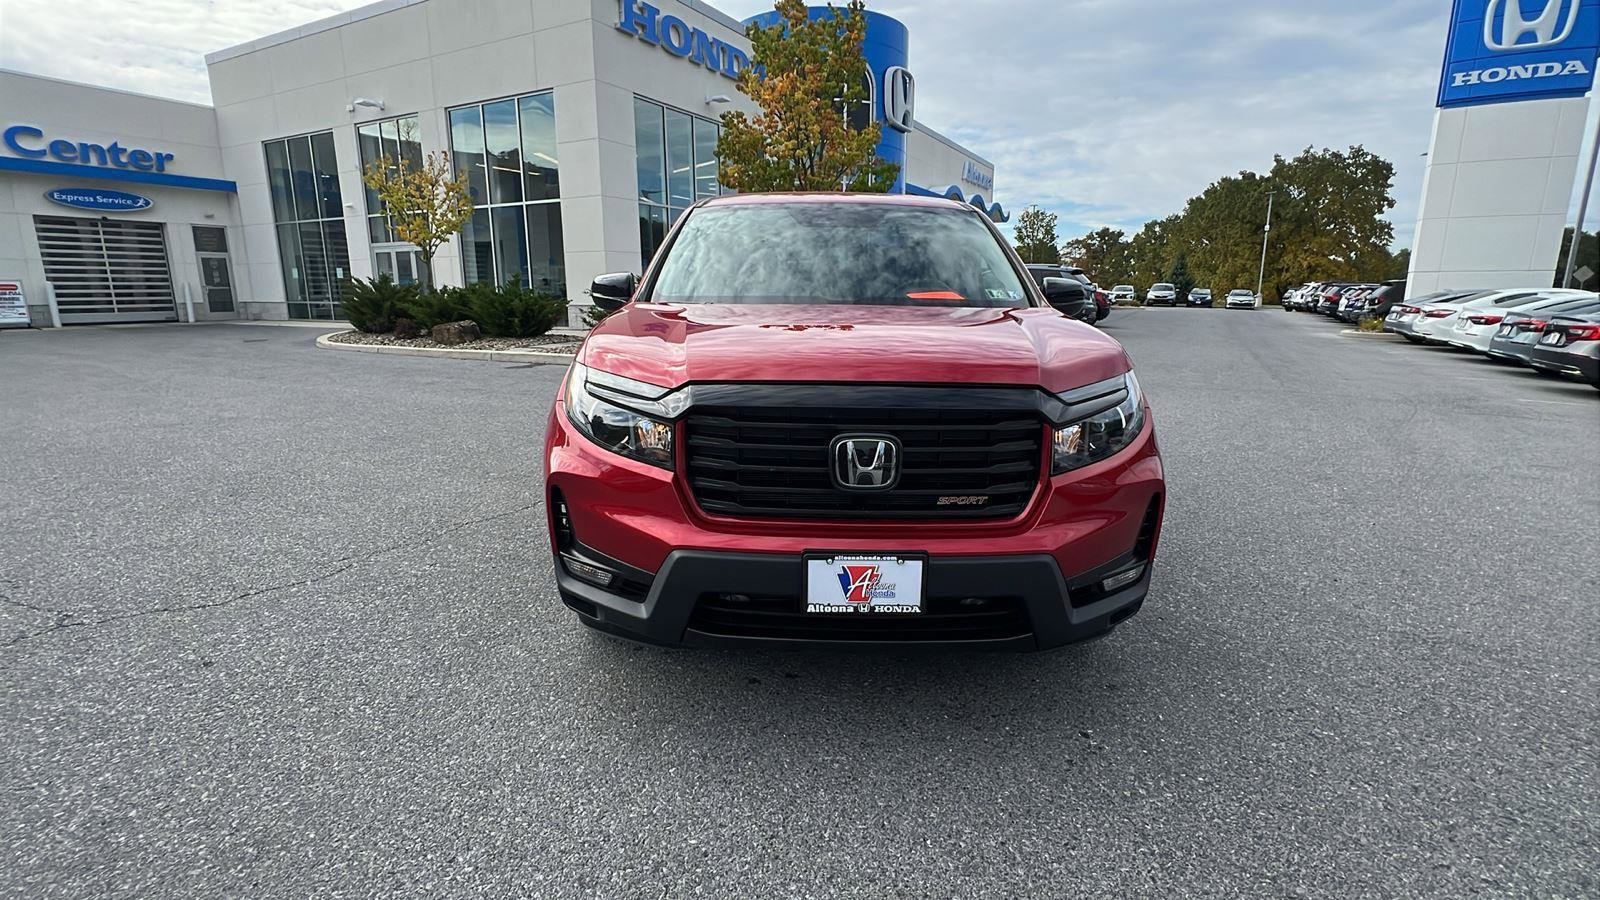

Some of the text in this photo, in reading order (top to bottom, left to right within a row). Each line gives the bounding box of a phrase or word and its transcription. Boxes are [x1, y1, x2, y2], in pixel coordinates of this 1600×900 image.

[1451, 60, 1589, 87] HONDA
[3, 125, 174, 172] Center
[53, 192, 133, 205] Express Service
[937, 496, 988, 505] SPORT
[807, 603, 921, 613] Altoona HONDA
